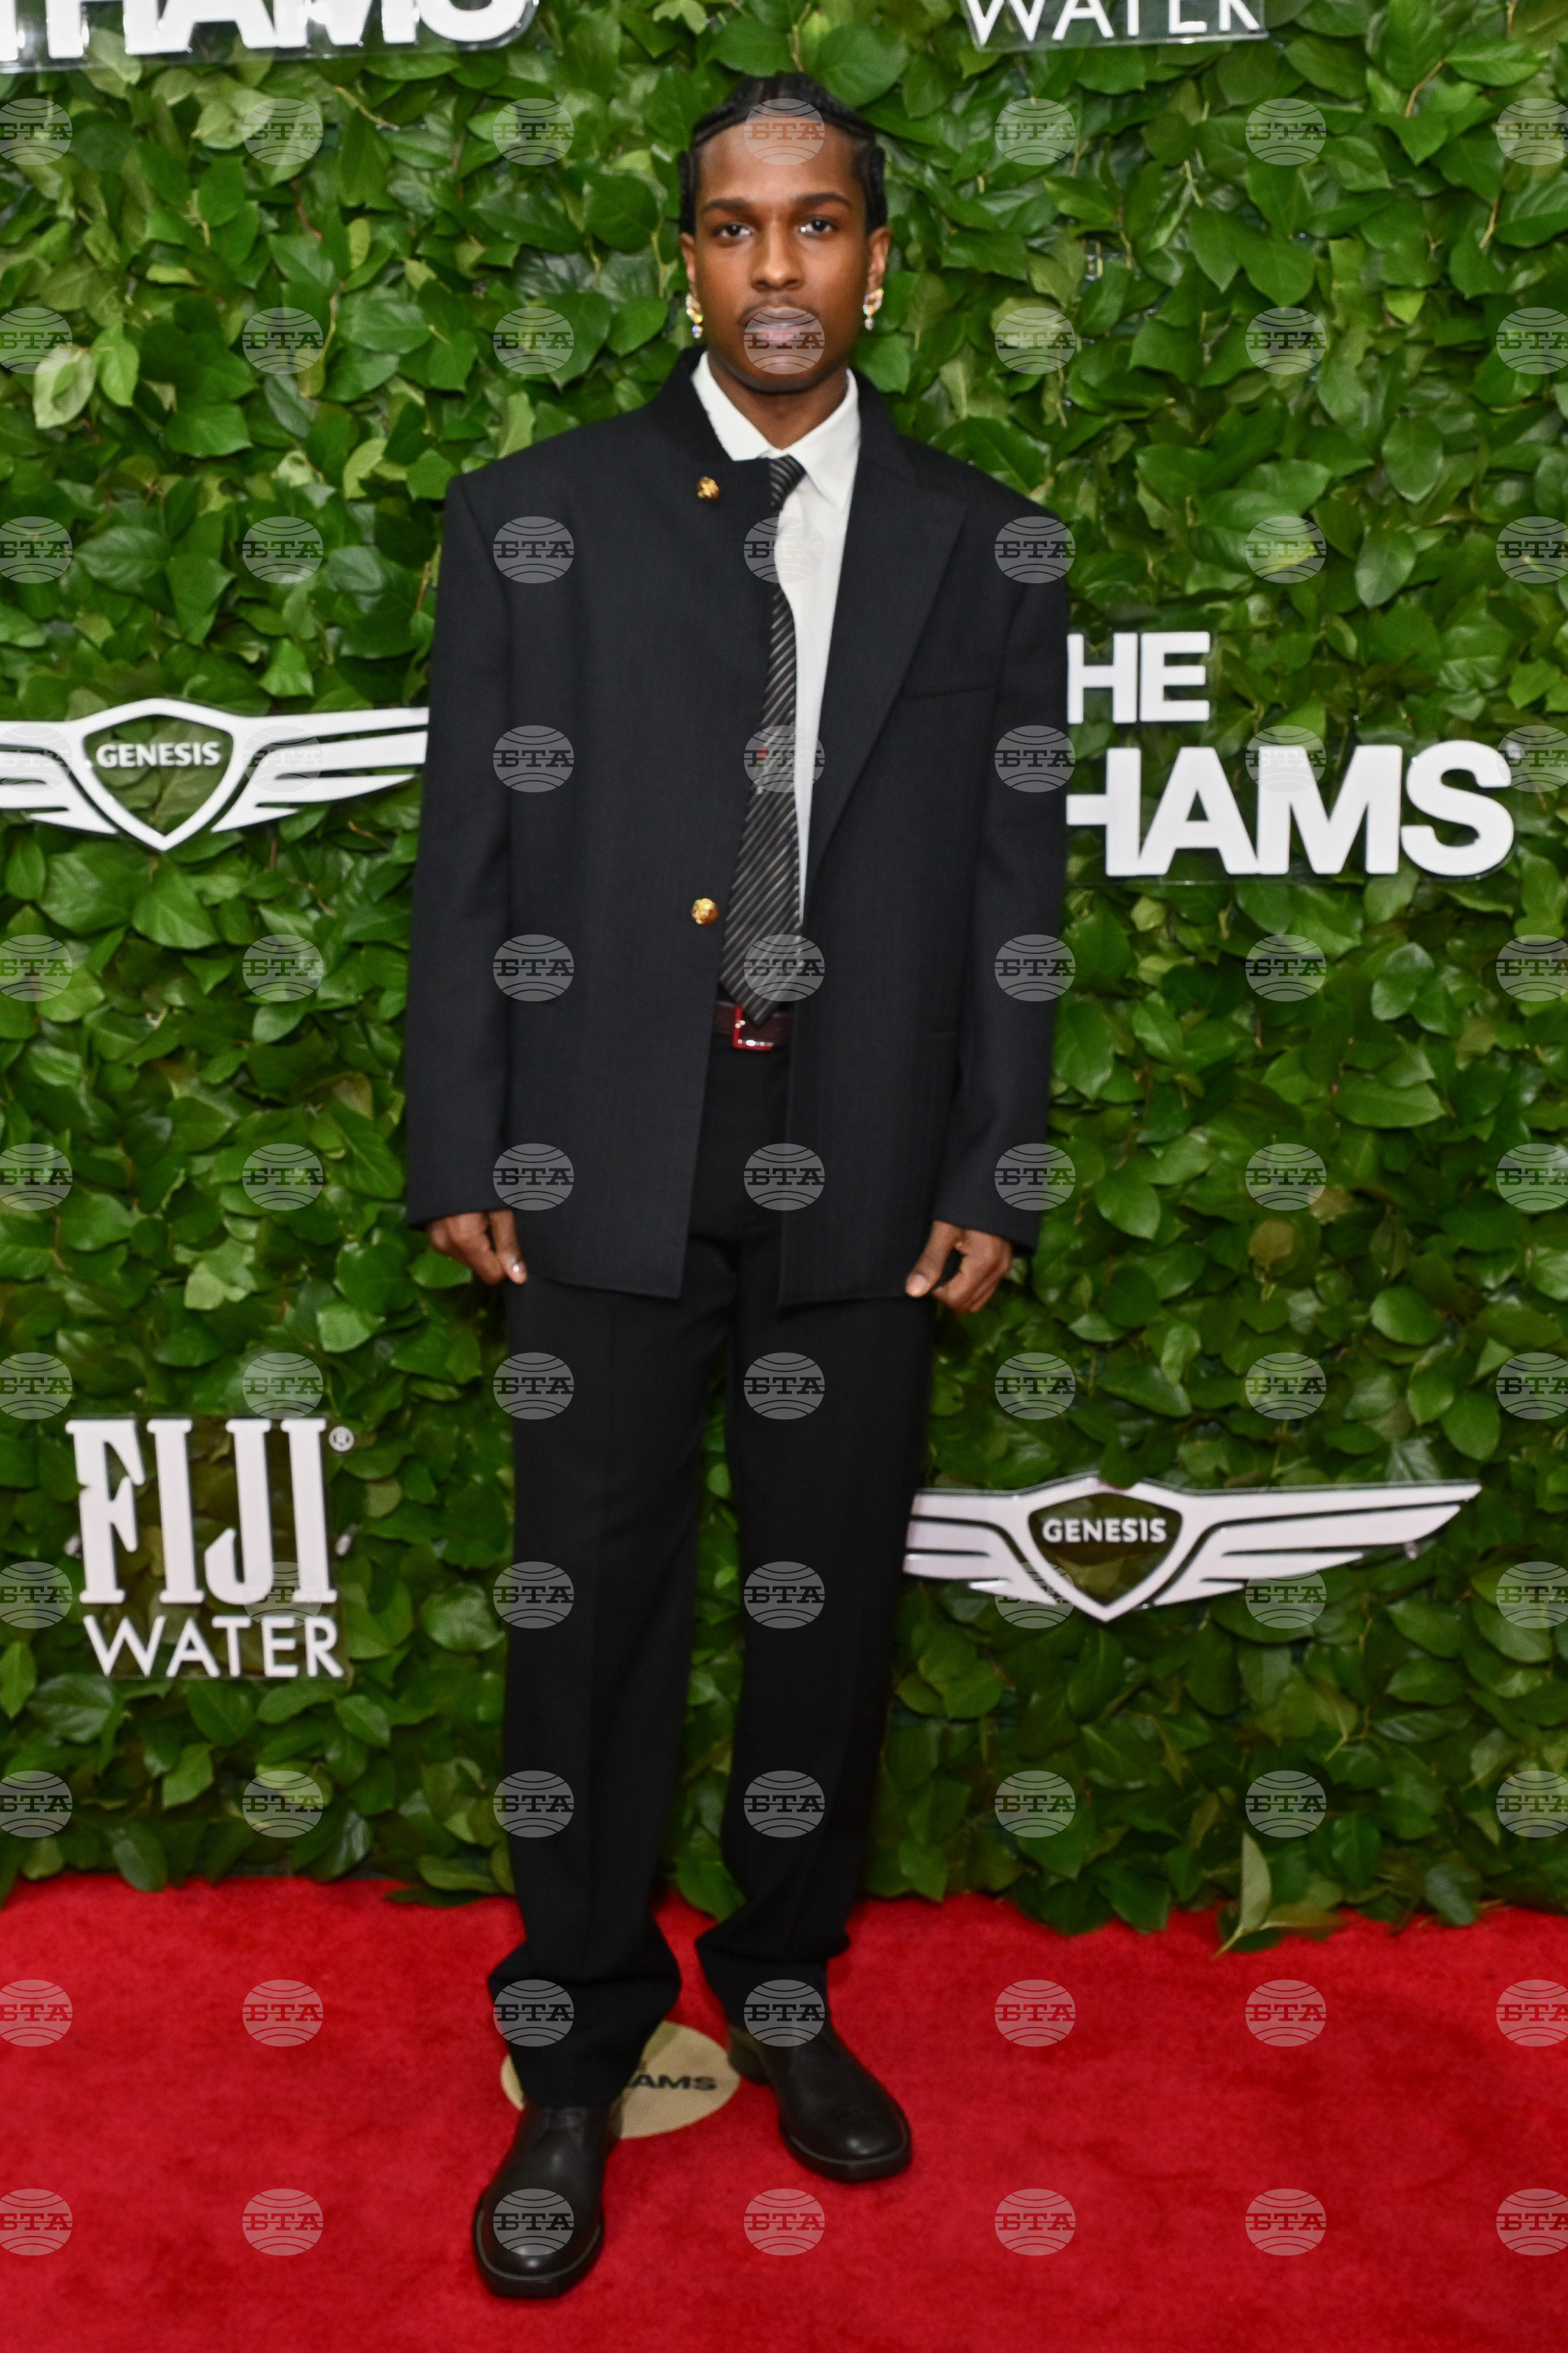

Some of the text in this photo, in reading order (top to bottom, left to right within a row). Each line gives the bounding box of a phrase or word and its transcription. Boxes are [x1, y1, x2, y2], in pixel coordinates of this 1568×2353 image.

[96, 741, 222, 768] GENESIS
[1042, 1518, 1167, 1543] GENESIS
[82, 1615, 344, 1677] WATER
